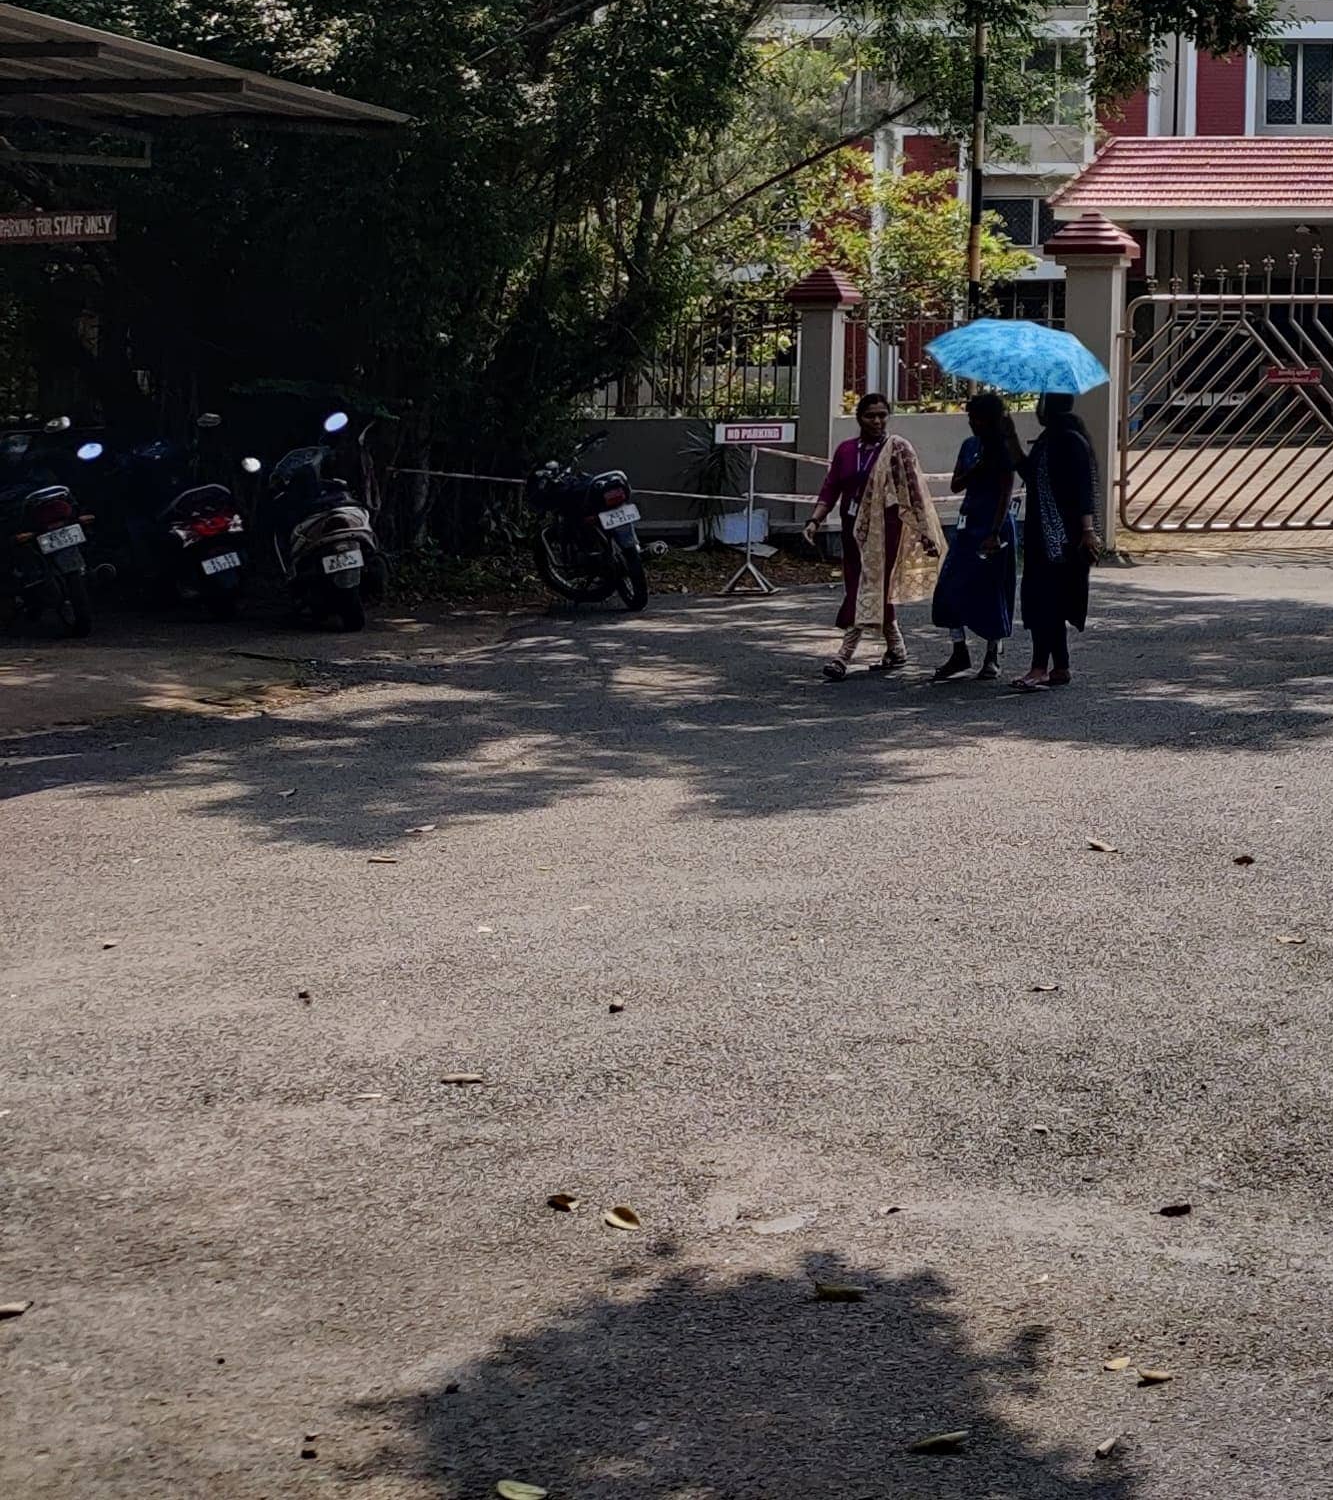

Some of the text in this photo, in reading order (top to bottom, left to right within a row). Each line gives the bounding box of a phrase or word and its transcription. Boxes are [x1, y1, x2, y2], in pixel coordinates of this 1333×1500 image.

[36, 218, 52, 235] FOR
[54, 215, 83, 235] STAFF
[84, 214, 112, 234] ONLY
[727, 428, 779, 439] NO PARKING
